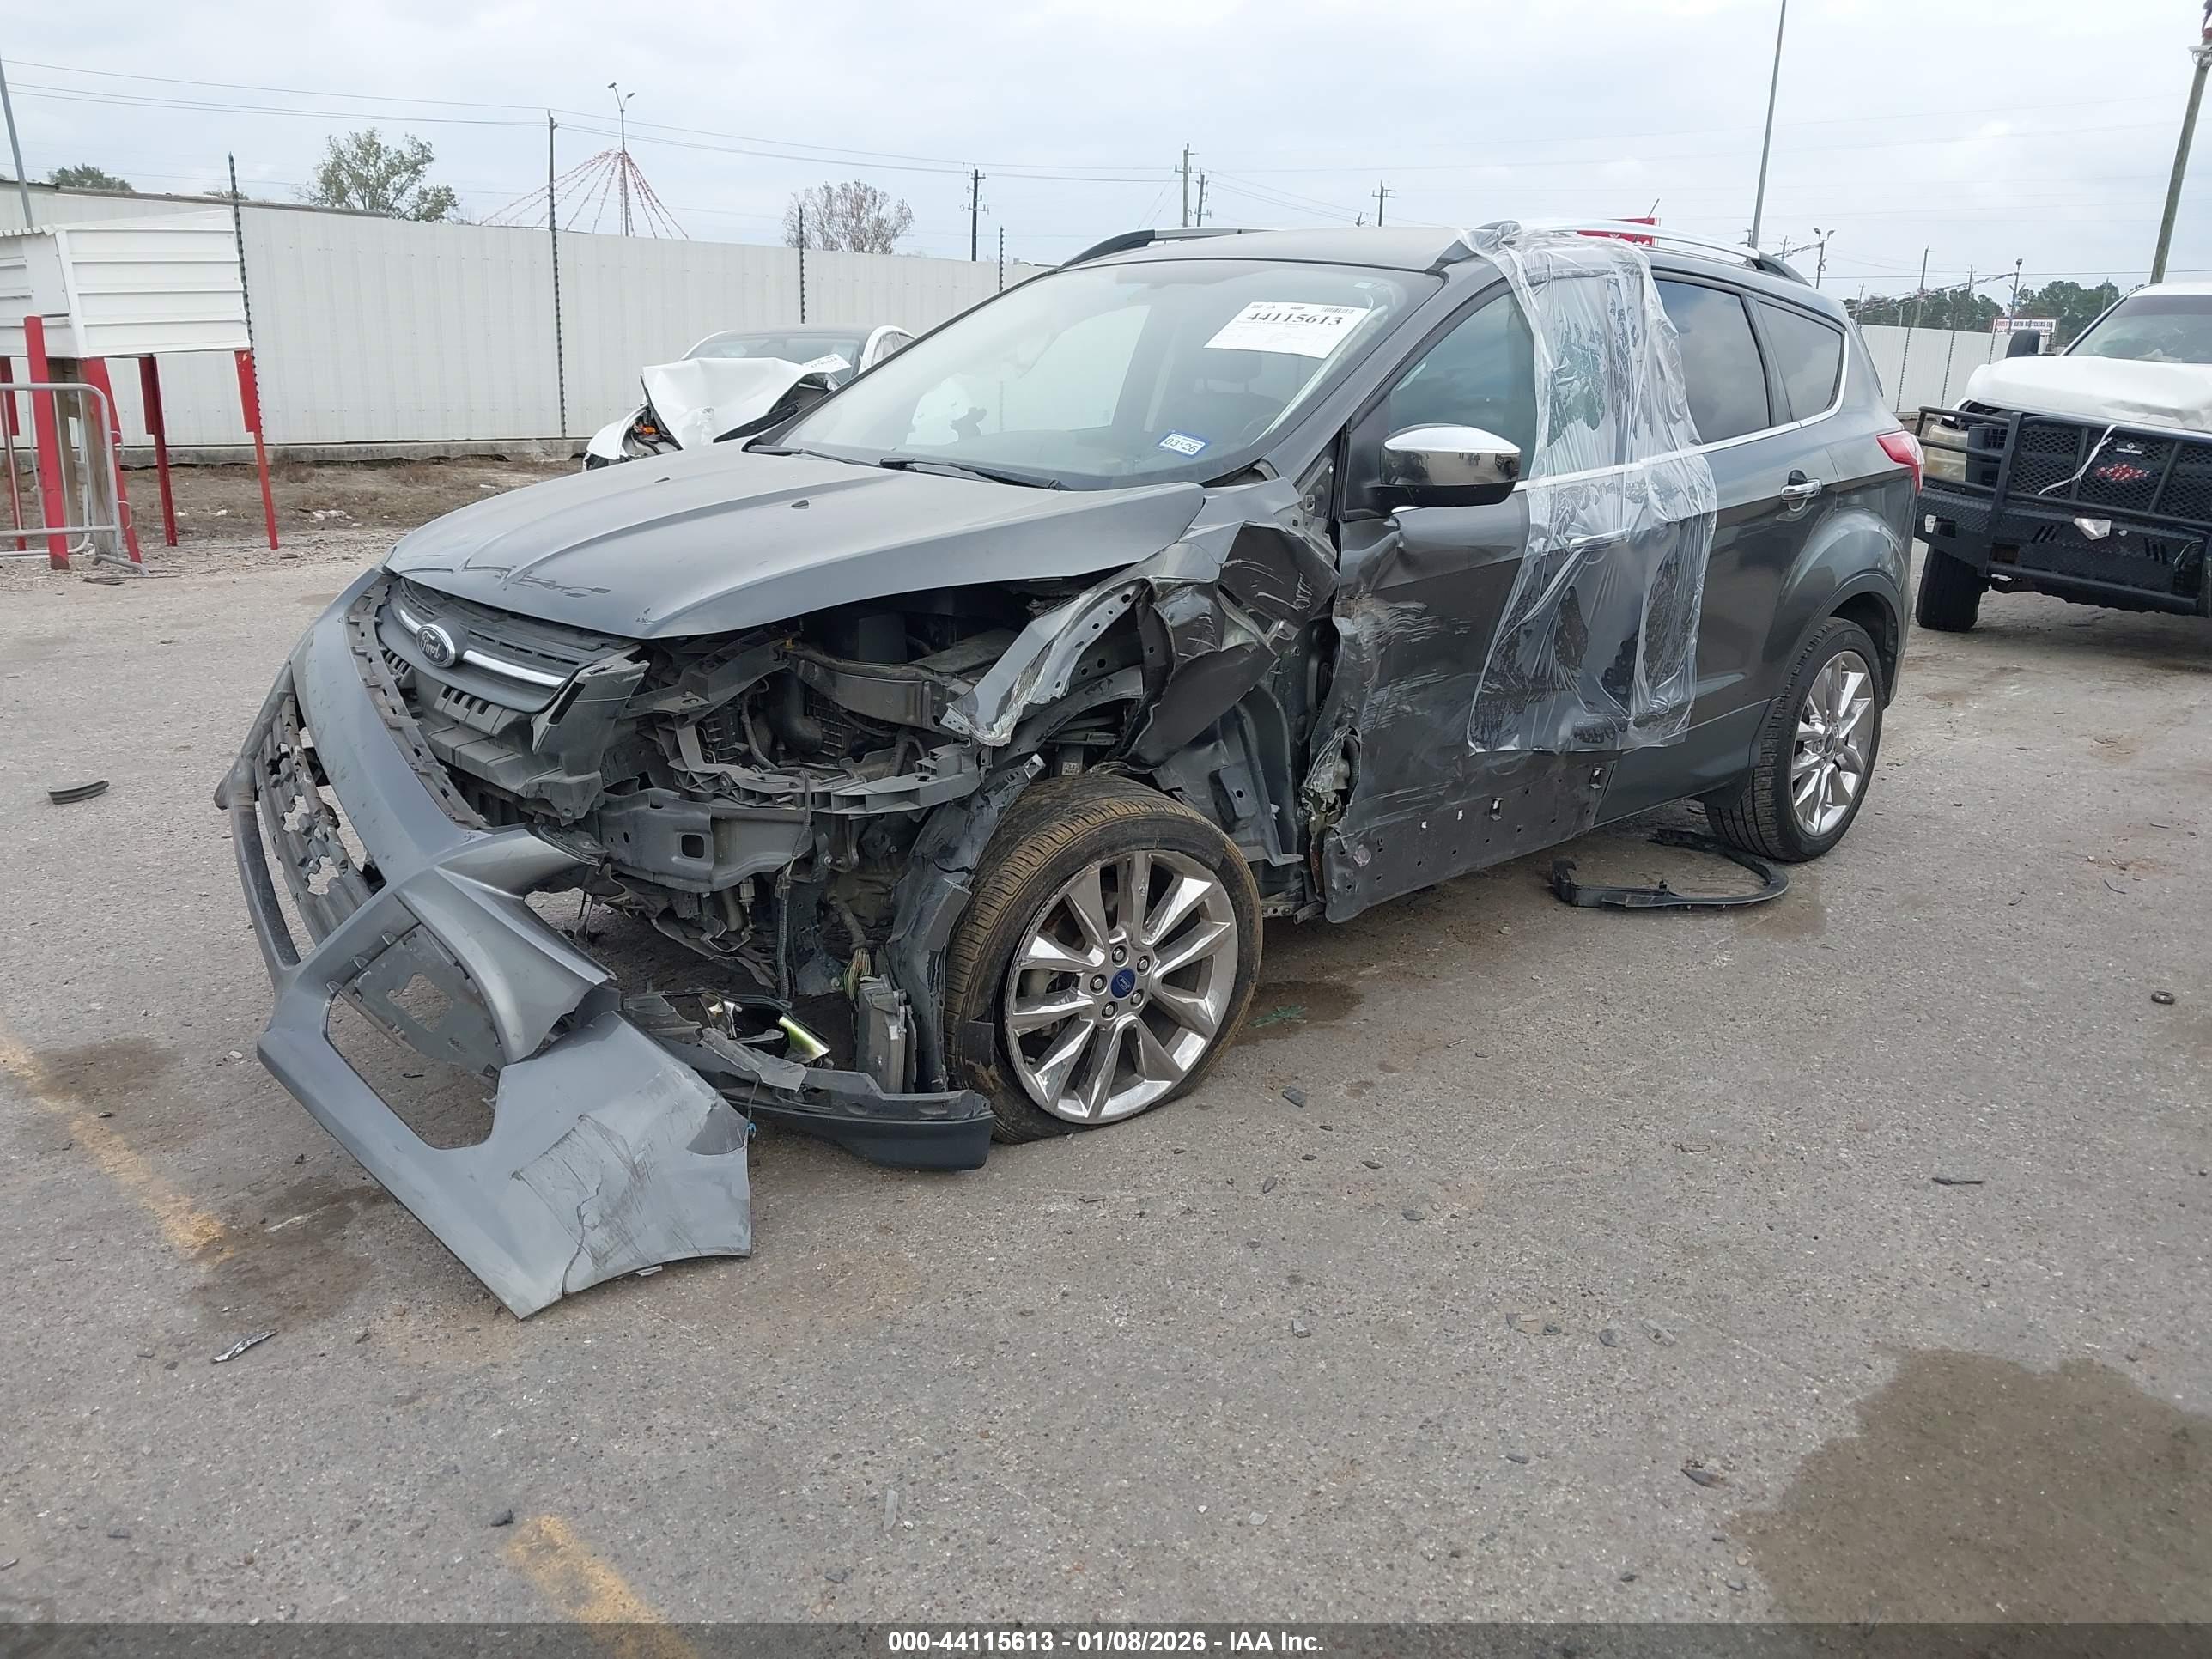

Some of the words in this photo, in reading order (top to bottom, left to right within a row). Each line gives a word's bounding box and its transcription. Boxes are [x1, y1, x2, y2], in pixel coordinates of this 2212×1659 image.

[1247, 312, 1343, 325] 44115613
[1164, 438, 1181, 447] 03
[1181, 443, 1199, 453] 26
[421, 630, 441, 659] Ford
